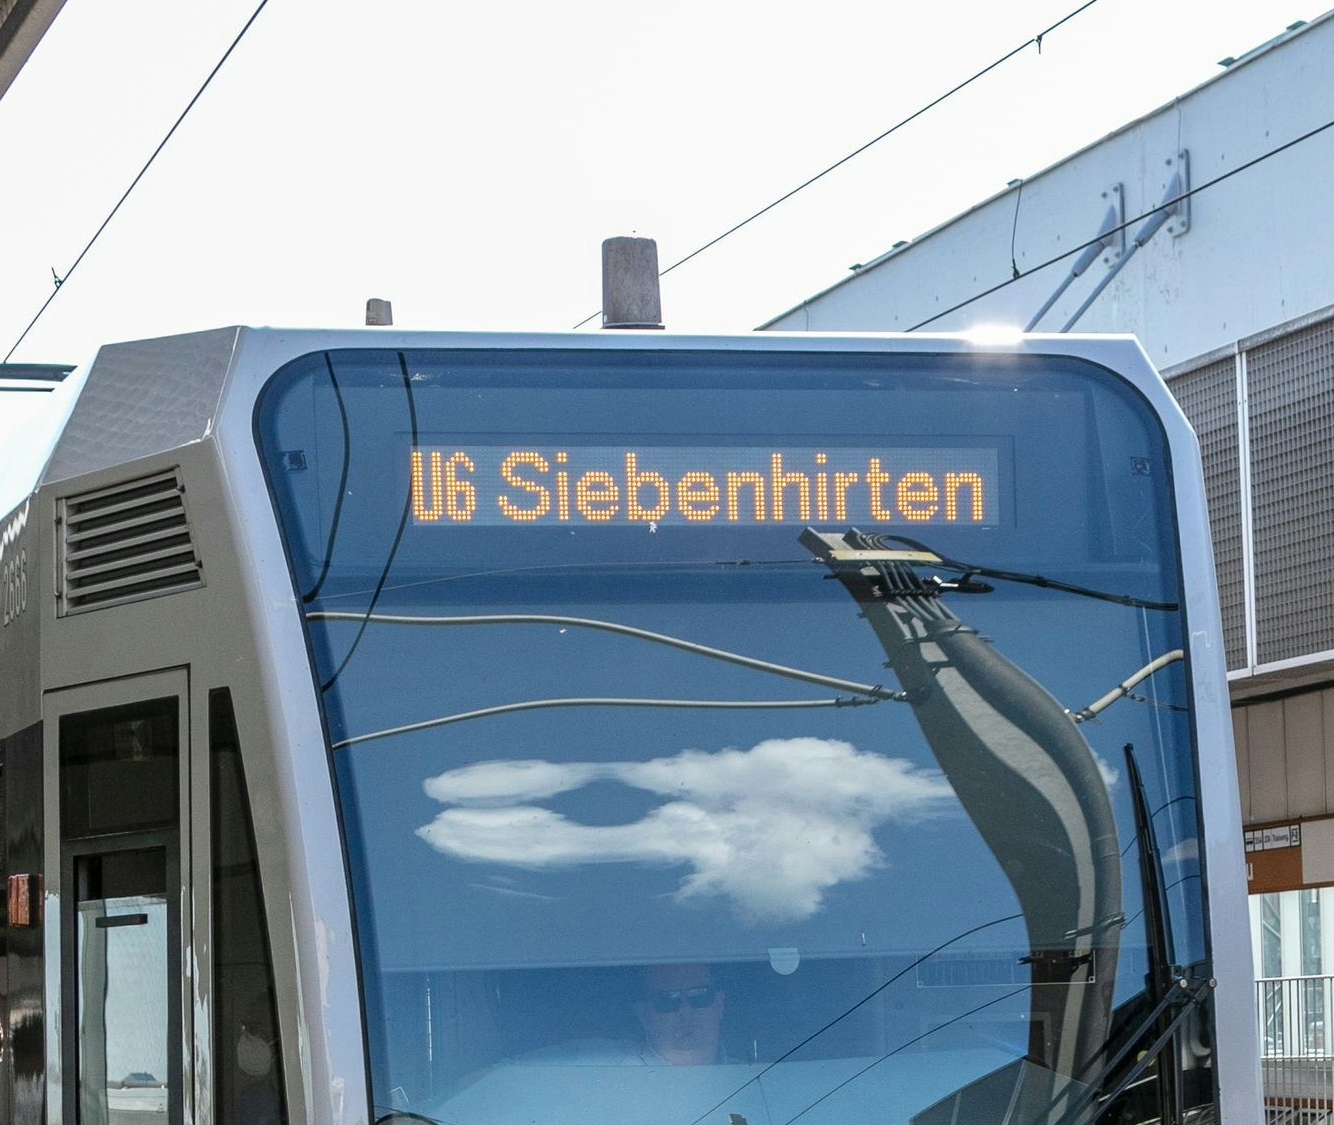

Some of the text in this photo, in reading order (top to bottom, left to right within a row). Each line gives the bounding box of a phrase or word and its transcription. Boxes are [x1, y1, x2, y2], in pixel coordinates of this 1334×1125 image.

[411, 450, 984, 522] U6 Siebenhirten
[3, 548, 27, 627] 2666
